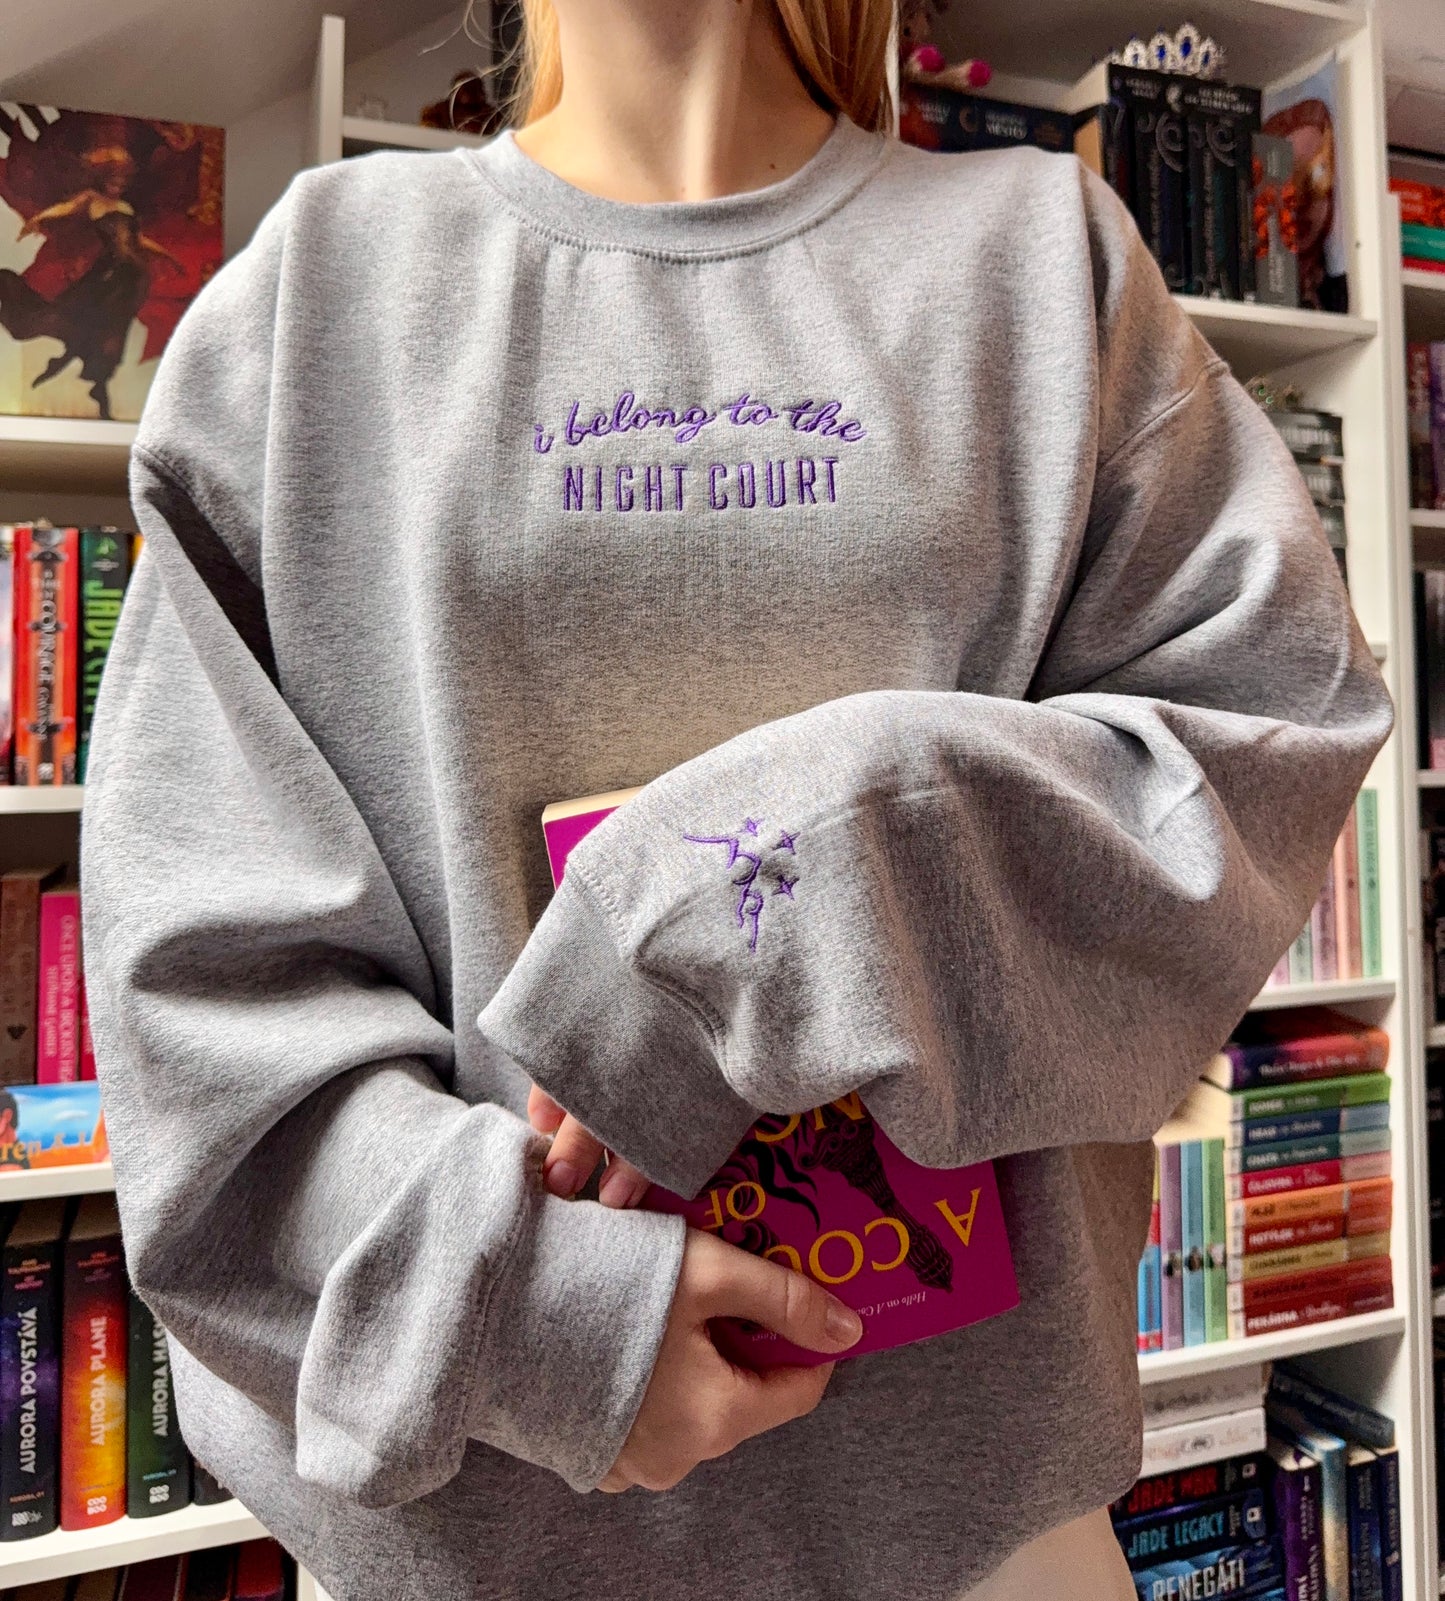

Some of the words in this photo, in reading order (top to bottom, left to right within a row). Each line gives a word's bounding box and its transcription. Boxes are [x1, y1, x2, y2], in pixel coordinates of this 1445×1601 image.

[533, 424, 554, 453] i
[565, 391, 716, 446] belong
[723, 393, 779, 426] to
[784, 399, 867, 442] the
[563, 463, 688, 512] NIGHT
[708, 456, 839, 510] COURT
[84, 580, 123, 653] JADE
[700, 1180, 767, 1231] OF
[933, 1187, 982, 1248] A
[886, 1299, 900, 1309] on
[901, 1290, 926, 1306] Hello
[17, 1306, 38, 1396] POVSTÁVÁ
[90, 1316, 107, 1372] PLANE
[90, 1373, 107, 1447] AURORA
[152, 1364, 169, 1438] AURORA
[20, 1398, 37, 1475] AURORA
[1127, 1525, 1169, 1558] JADE
[1174, 1511, 1225, 1546] LEGACY
[1152, 1557, 1246, 1601] RENEGÁTI
